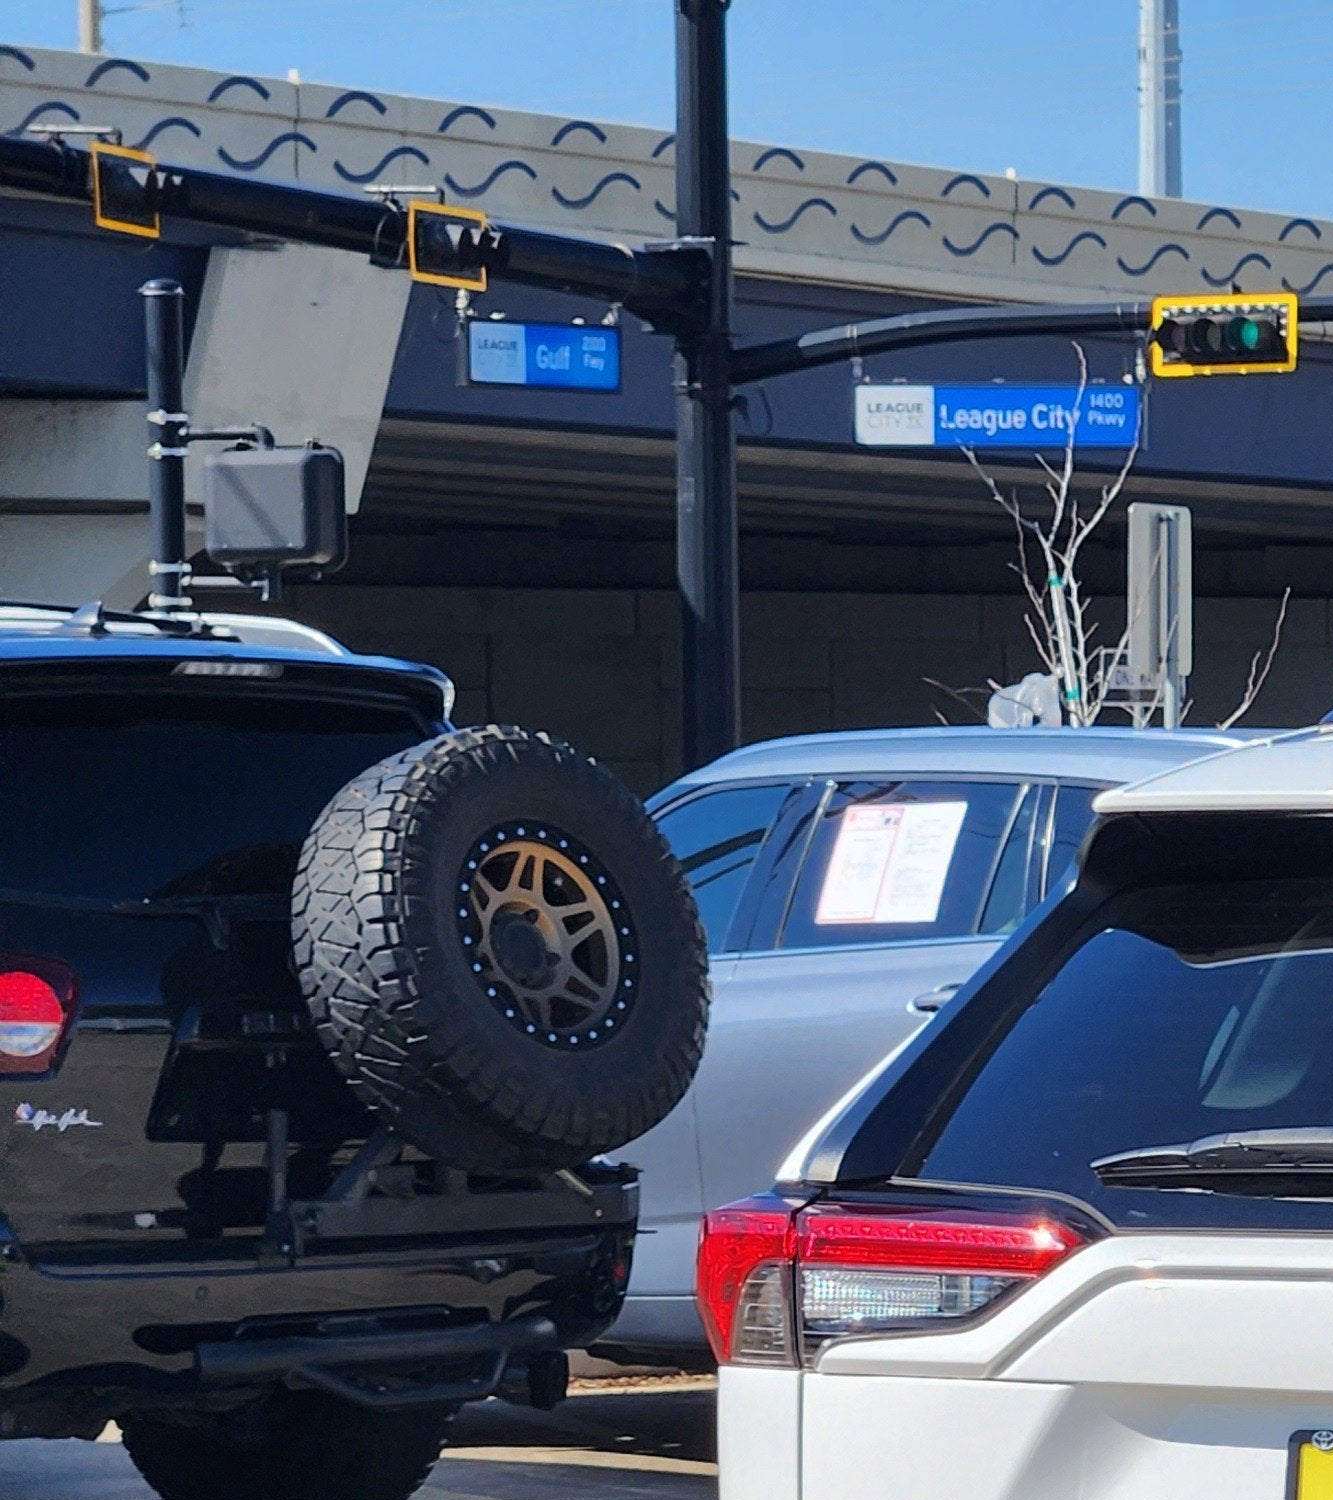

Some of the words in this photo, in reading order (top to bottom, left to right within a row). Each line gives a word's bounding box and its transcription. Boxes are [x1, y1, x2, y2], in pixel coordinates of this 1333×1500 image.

[536, 344, 571, 370] Gulf
[867, 402, 924, 414] LEAGUE
[1089, 392, 1124, 408] 1400
[940, 403, 1027, 436] League
[1031, 402, 1081, 434] City
[1087, 410, 1126, 428] Pkwy
